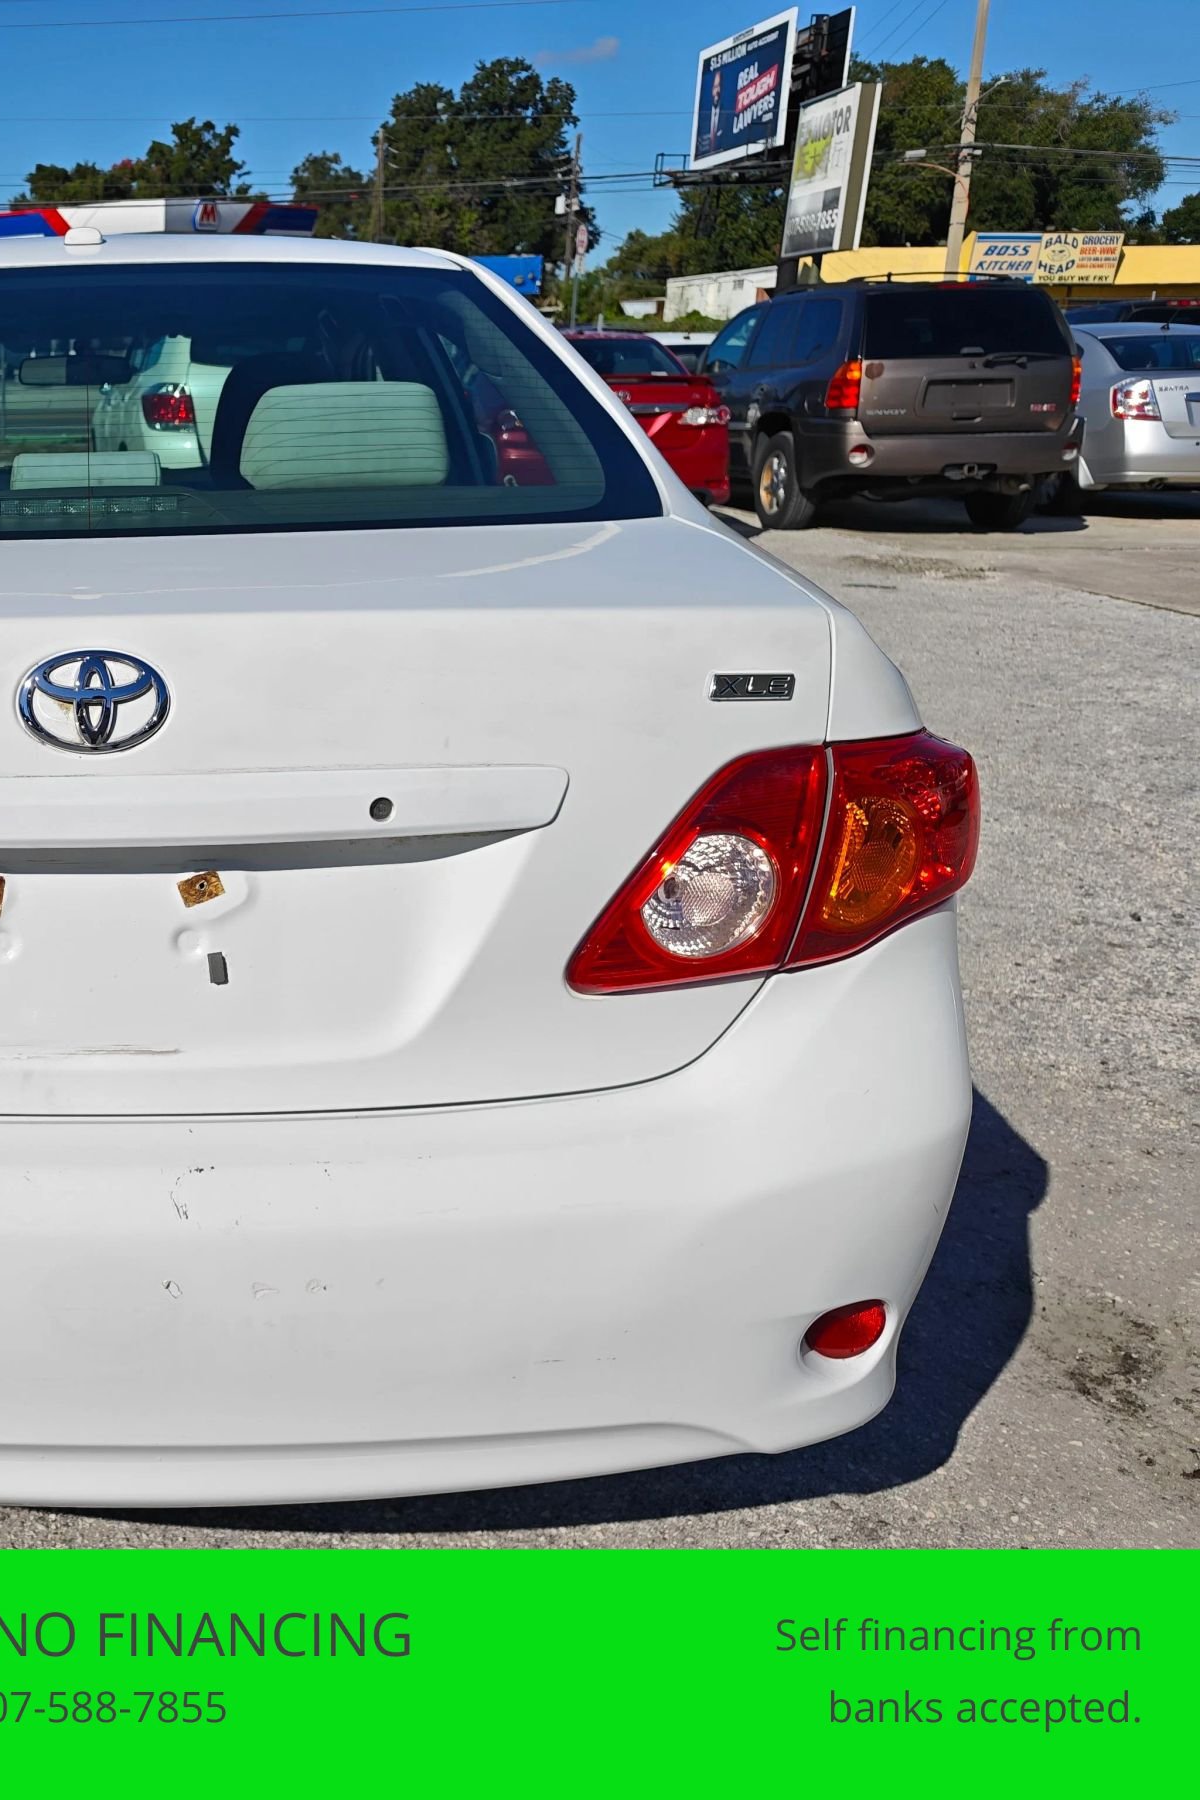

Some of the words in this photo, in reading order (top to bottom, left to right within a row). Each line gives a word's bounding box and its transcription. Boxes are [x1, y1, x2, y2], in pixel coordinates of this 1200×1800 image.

[722, 43, 747, 64] MILLION
[737, 62, 759, 90] REAL
[738, 69, 776, 110] TOUGH
[733, 91, 776, 134] LAWYERS
[1044, 234, 1078, 249] BALD
[1082, 235, 1120, 245] GROCERY
[983, 245, 1031, 256] BOSS
[975, 260, 1033, 271] KITCHEN
[1038, 259, 1075, 274] HEAD
[719, 676, 791, 696] XLE
